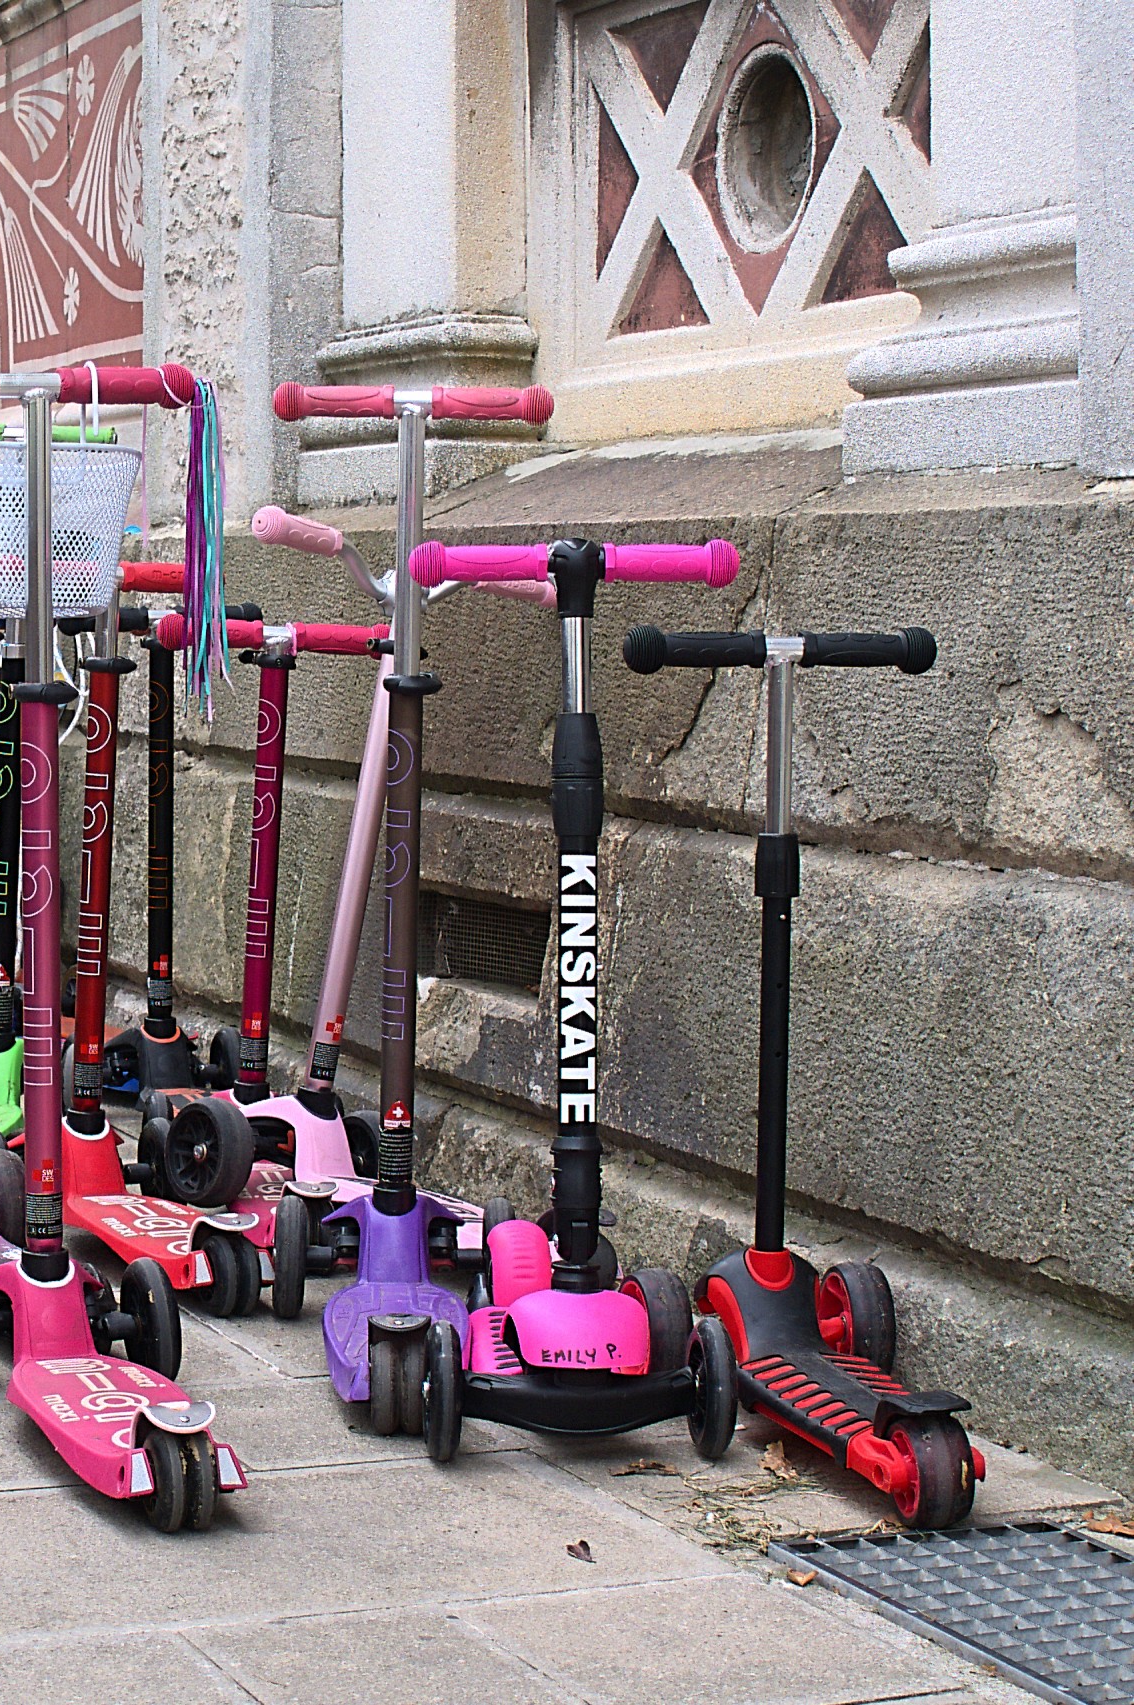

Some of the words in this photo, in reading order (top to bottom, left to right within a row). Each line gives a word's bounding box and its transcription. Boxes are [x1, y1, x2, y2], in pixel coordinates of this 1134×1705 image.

[560, 854, 597, 1123] KINSKATE
[541, 1348, 597, 1365] EMILY
[42, 1394, 90, 1423] maxi
